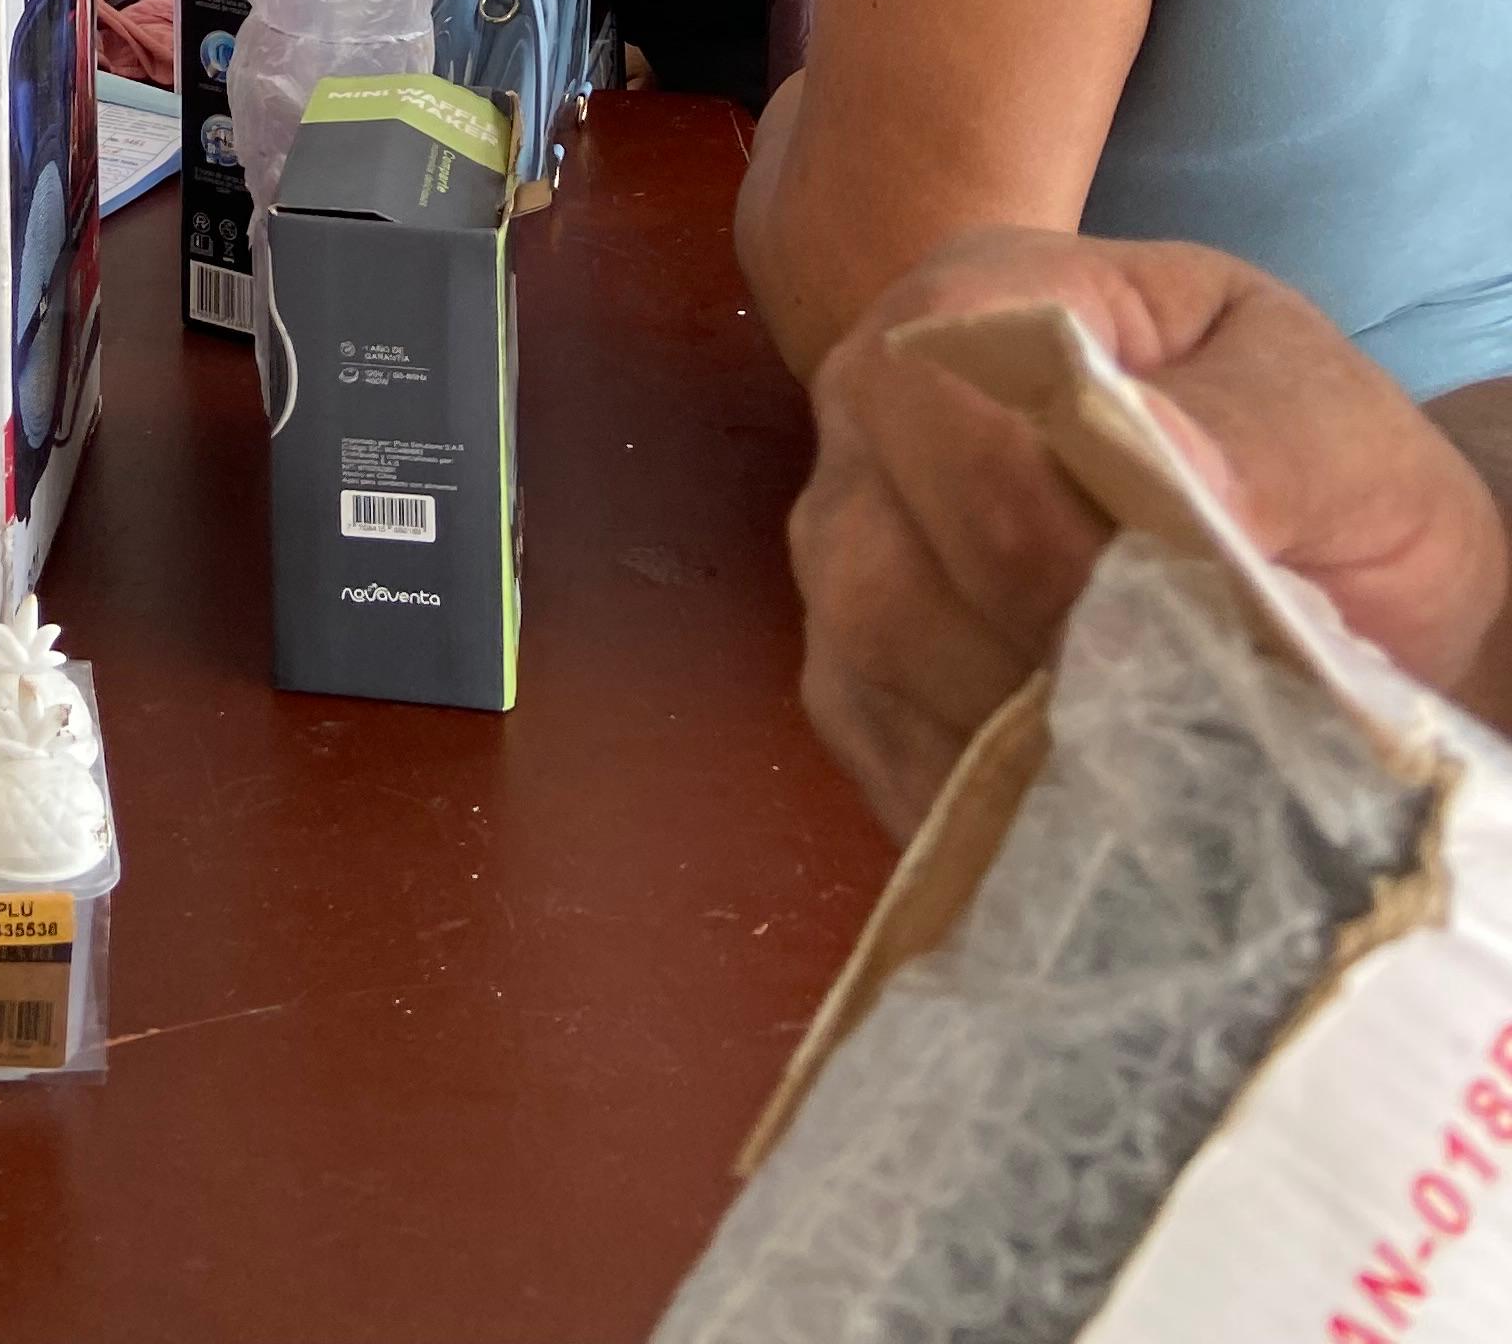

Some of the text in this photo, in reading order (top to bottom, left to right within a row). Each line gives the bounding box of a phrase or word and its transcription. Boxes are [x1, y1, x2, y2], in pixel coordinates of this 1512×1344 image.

[328, 88, 499, 134] MINI WAFFLE
[400, 95, 499, 146] MAKER
[341, 582, 441, 606] novaventa
